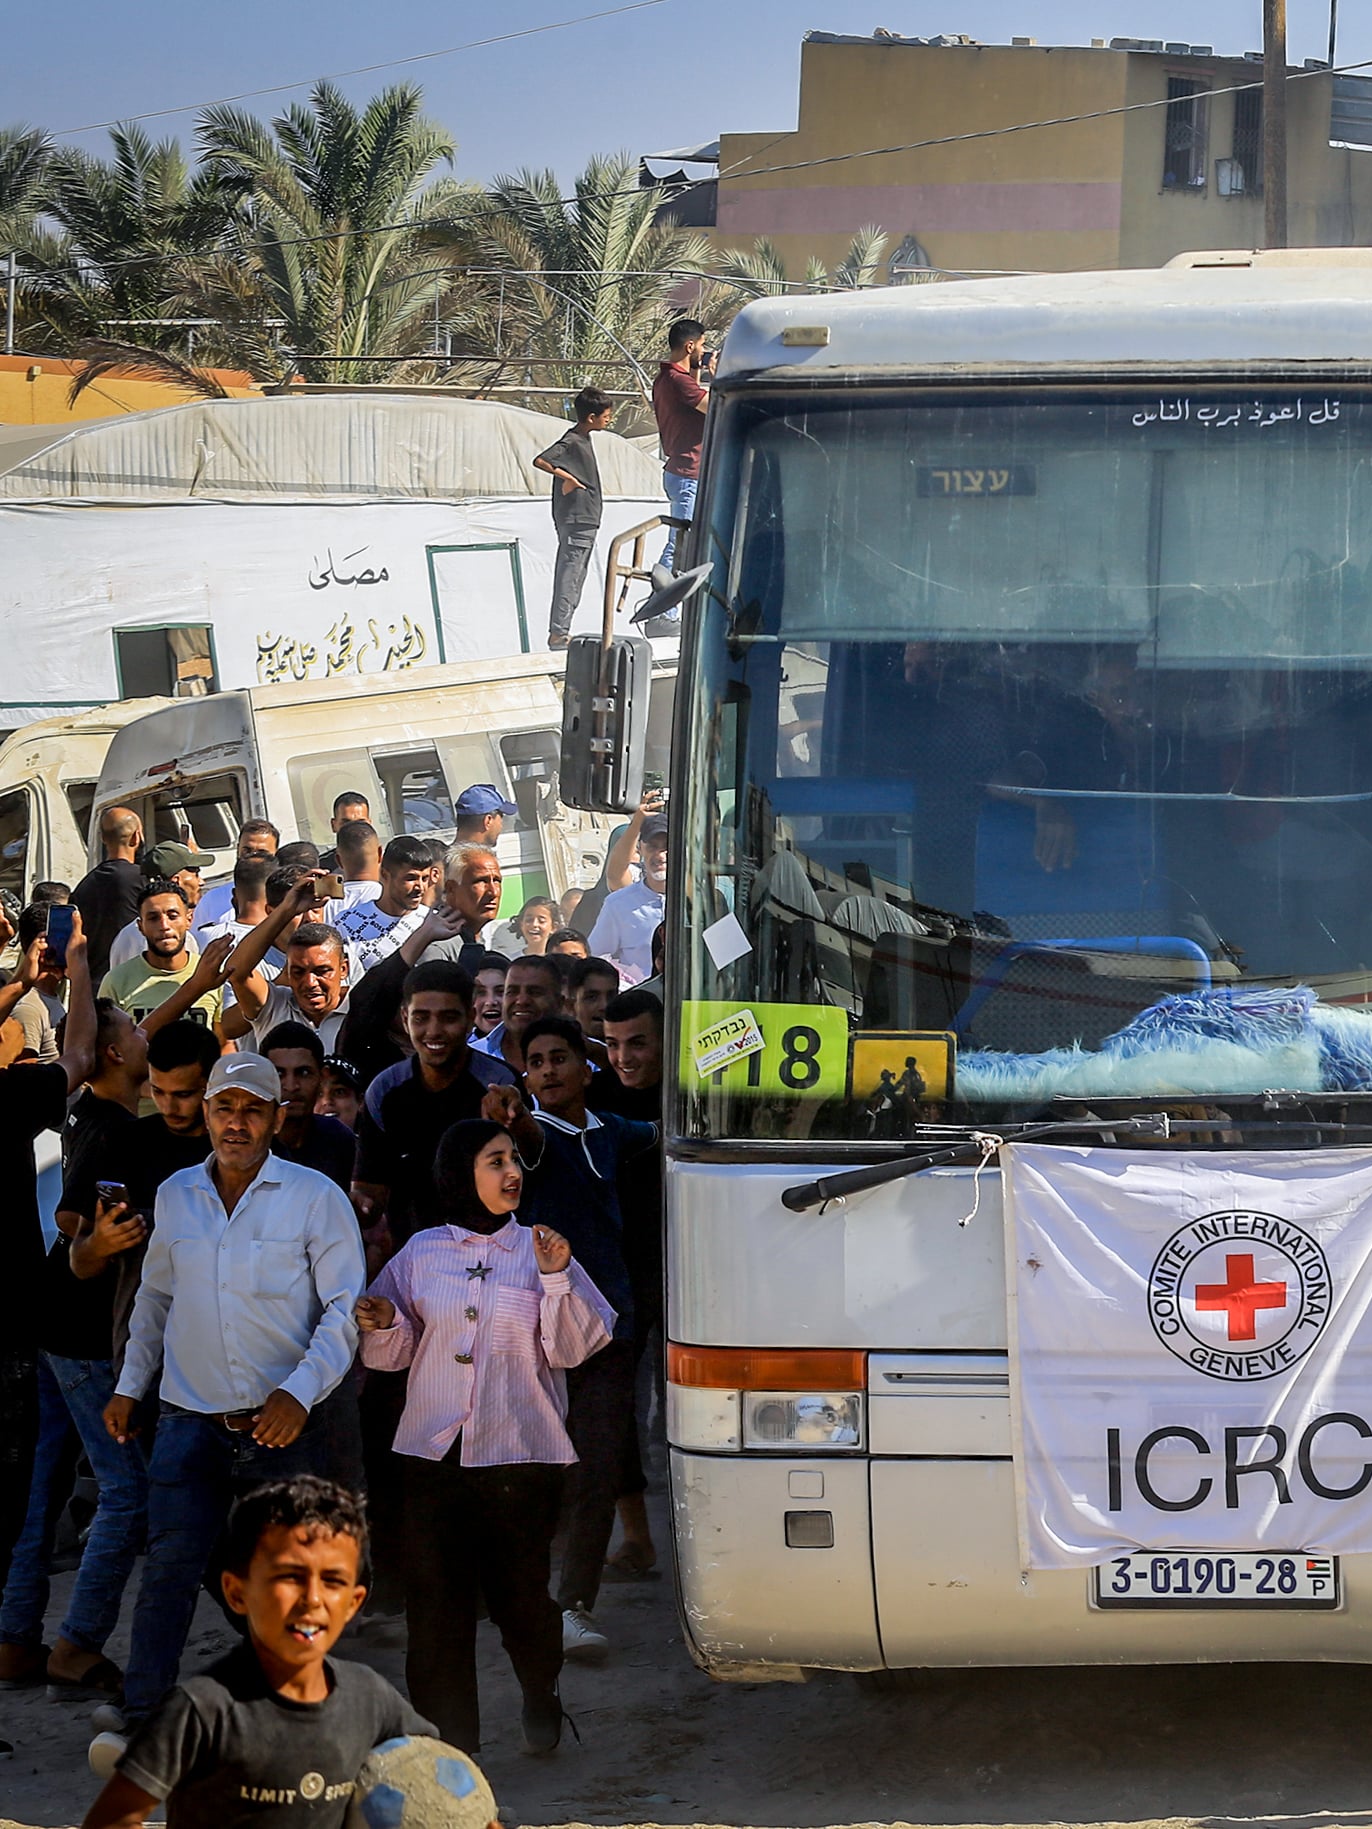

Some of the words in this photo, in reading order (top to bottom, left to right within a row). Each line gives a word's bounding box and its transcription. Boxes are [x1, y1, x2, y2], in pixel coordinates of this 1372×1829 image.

[1132, 398, 1190, 427] الناس
[1197, 405, 1241, 427] برب
[1309, 399, 1340, 425] قل
[932, 469, 1009, 493] עצור
[697, 1017, 748, 1049] נבדקתי
[1153, 1239, 1192, 1336] COMITE
[1191, 1215, 1327, 1330] INTERNATIONAL
[1189, 1341, 1296, 1377] GENEVE
[1111, 1557, 1298, 1595] 3-0190-28
[1312, 1579, 1326, 1596] P
[240, 1785, 297, 1805] LIMIT
